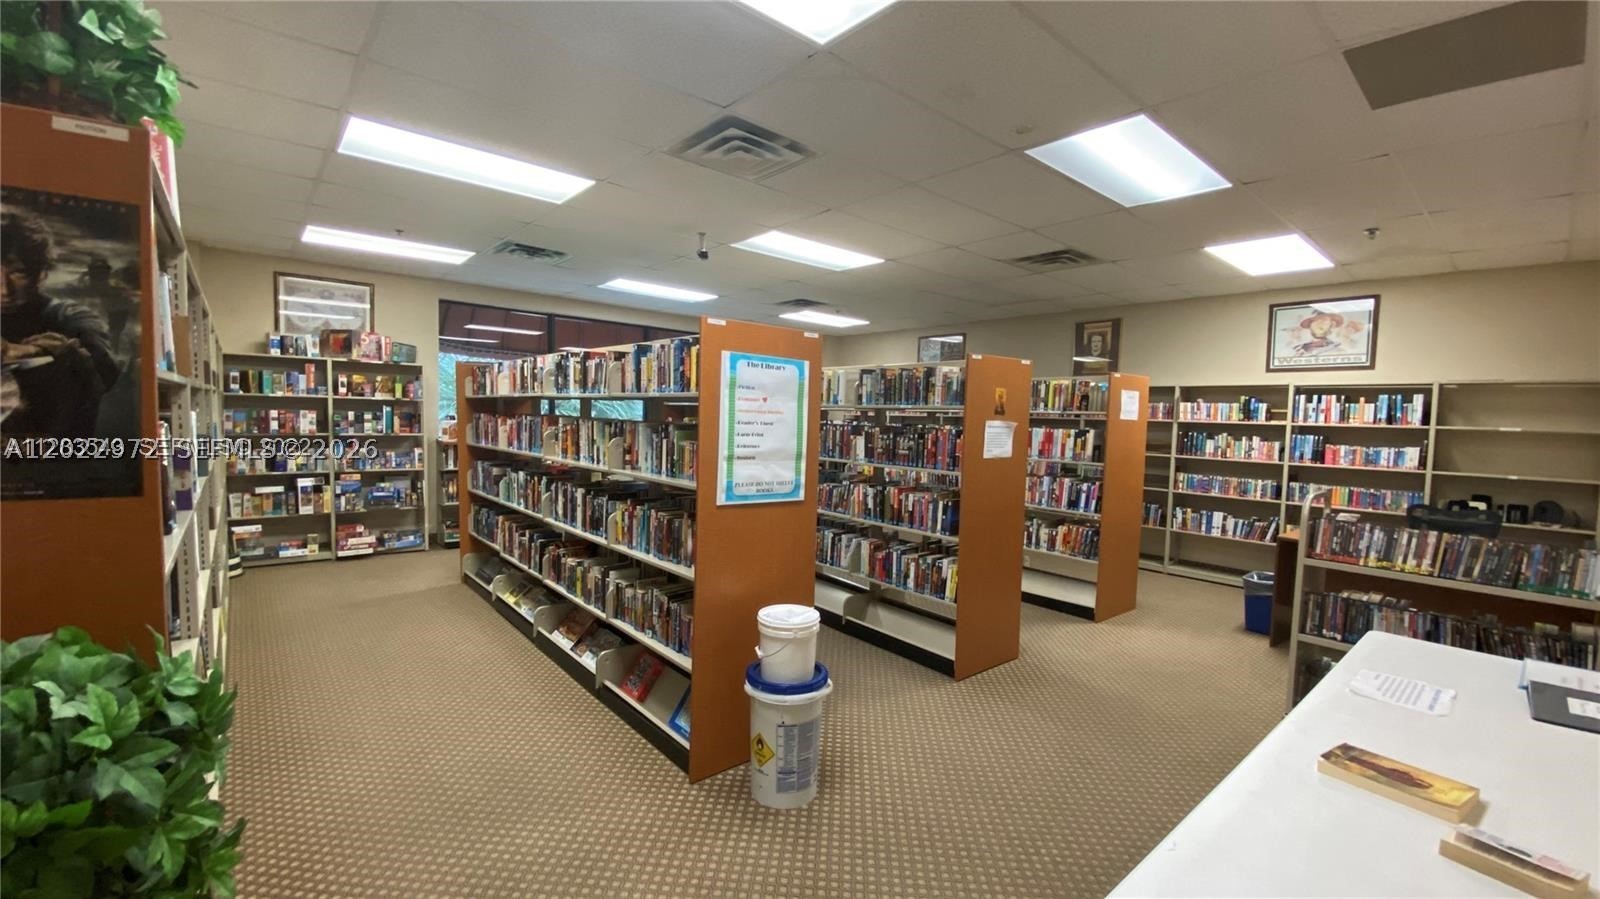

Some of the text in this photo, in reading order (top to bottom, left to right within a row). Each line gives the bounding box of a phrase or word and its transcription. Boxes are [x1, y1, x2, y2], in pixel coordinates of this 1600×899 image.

[1277, 356, 1362, 365] Westerns
[747, 361, 786, 371] The Library
